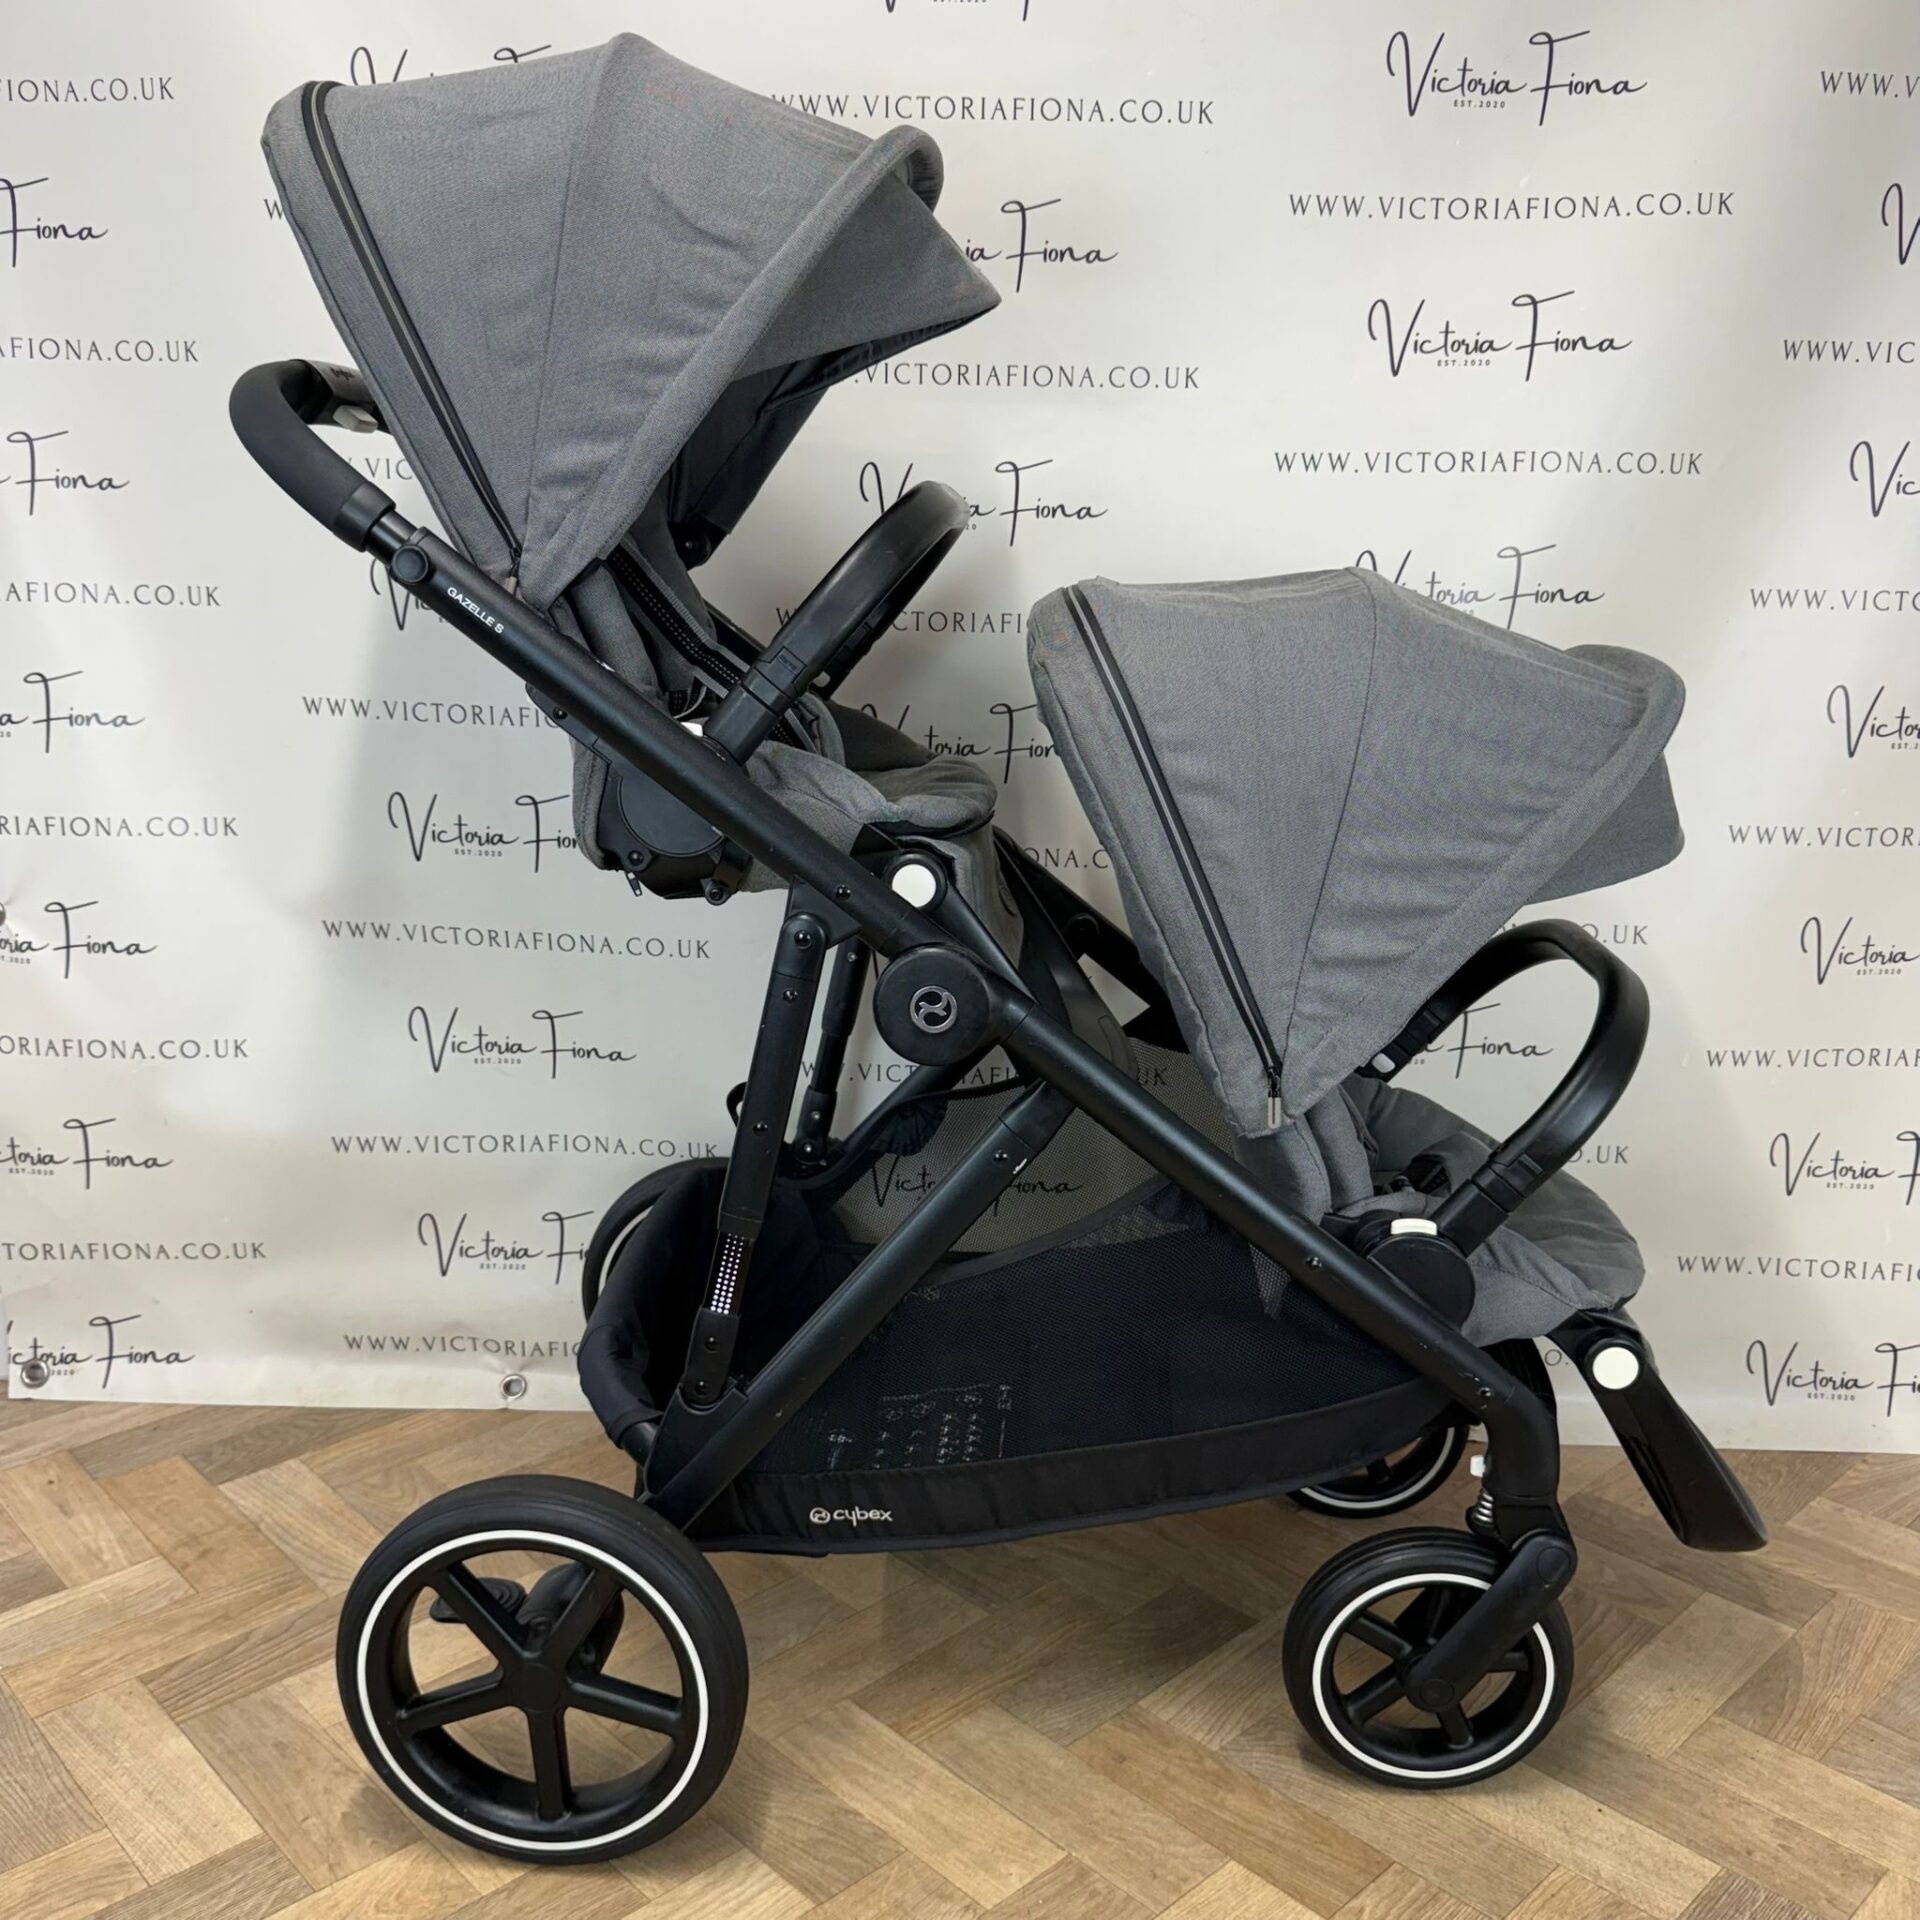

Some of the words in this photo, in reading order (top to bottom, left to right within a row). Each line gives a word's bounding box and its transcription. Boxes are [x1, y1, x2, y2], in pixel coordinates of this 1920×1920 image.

[0, 77, 174, 102] IONA.CO.UK
[1386, 30, 1527, 117] Victoria
[1529, 30, 1648, 126] Fiona
[1453, 99, 1506, 108] EST.2020
[0, 177, 109, 268] Fiona
[1289, 192, 1735, 220] WWW.VICTORIAFIONA.CO.UK
[1000, 198, 1119, 293] Fiona
[0, 337, 199, 362] FIONA.CO.UK
[1367, 299, 1512, 377] Victoria
[1512, 291, 1633, 382] Fiona
[1437, 359, 1491, 367] EST.2020
[7, 430, 130, 516] Fiona
[1274, 450, 1703, 475] WWW.VICTORIAFIONA.CO.UK
[995, 459, 1108, 547] Fiona
[447, 587, 496, 627] GAZELLE
[494, 623, 504, 634] S
[1497, 543, 1605, 631] Fiona
[1750, 588, 1920, 612] WWW.VICT
[23, 670, 146, 753] Fiona
[388, 791, 520, 861] Victoria
[1728, 824, 1920, 847] WWW.VICTOR
[44, 900, 158, 979] Fiona
[321, 919, 711, 959] WWW.VICTORIAFIONA.CO.UK
[1800, 916, 1920, 985] Victoria
[408, 1006, 538, 1072] Victoria
[531, 1010, 637, 1079] Fiona
[1447, 1003, 1554, 1079] Fiona
[63, 1118, 174, 1189] Fiona
[331, 1134, 719, 1159] WWW.VICTORIAFIONA.CO.UK
[1769, 1132, 1896, 1196] Victoria
[418, 1213, 544, 1276] Victoria
[1677, 1255, 1920, 1282] WWW.VICTORIAFI
[89, 1314, 195, 1389] Fiona
[1746, 1340, 1874, 1406] Victoria
[832, 1507, 893, 1527] cybex
